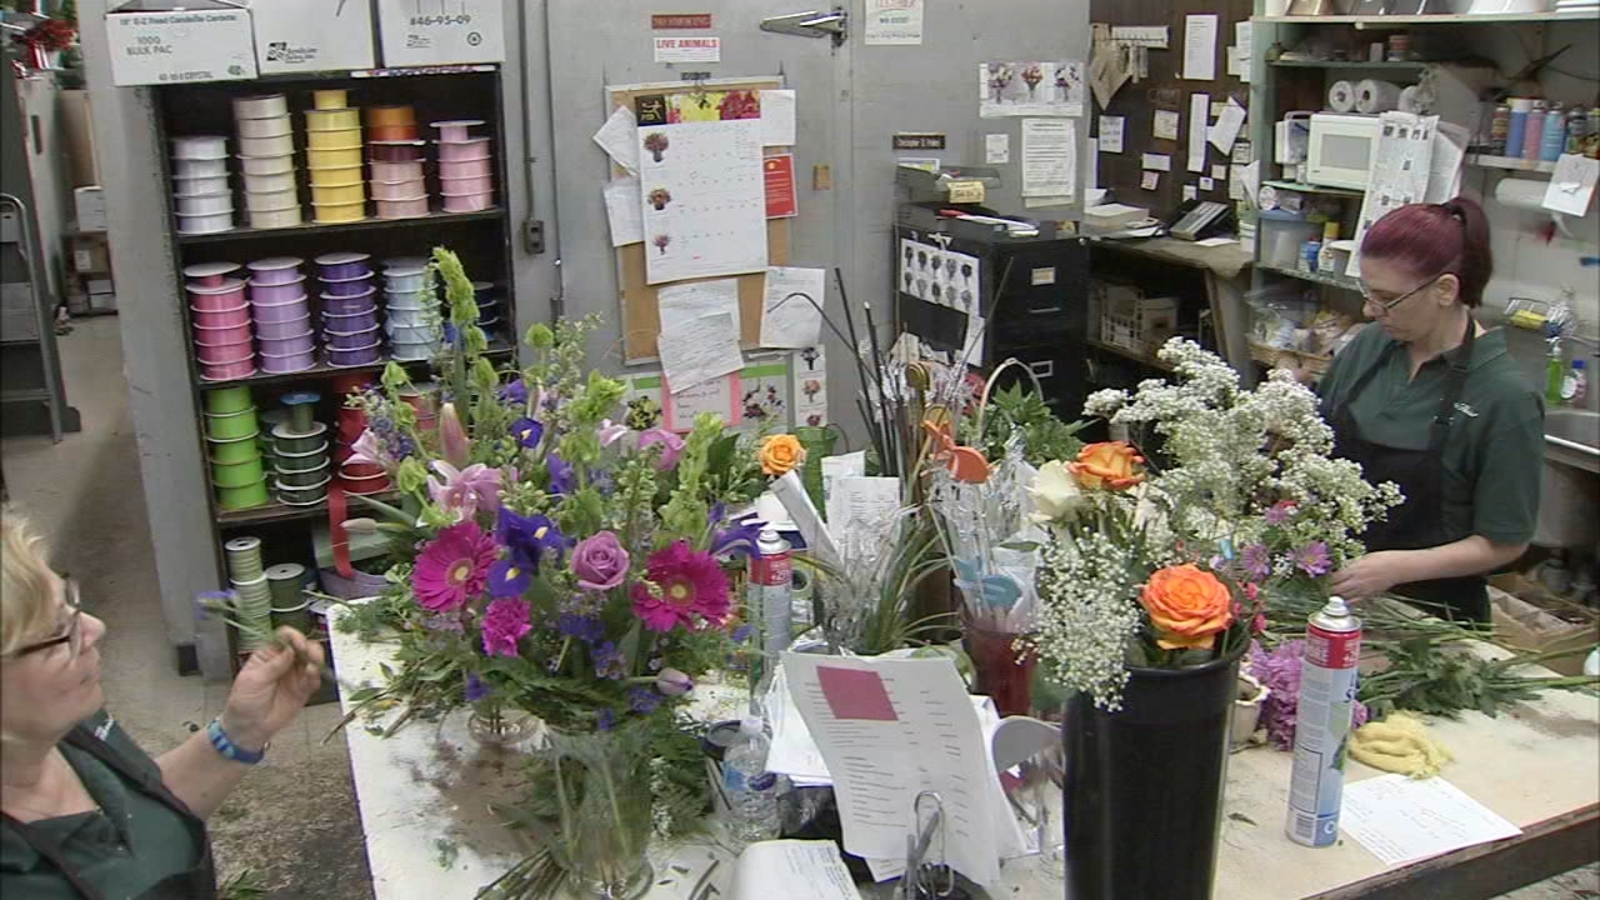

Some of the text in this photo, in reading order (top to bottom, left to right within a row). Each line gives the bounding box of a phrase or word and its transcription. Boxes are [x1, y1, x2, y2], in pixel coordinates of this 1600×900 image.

[656, 39, 717, 49] LIVE ANIMALS
[153, 45, 173, 54] PAC
